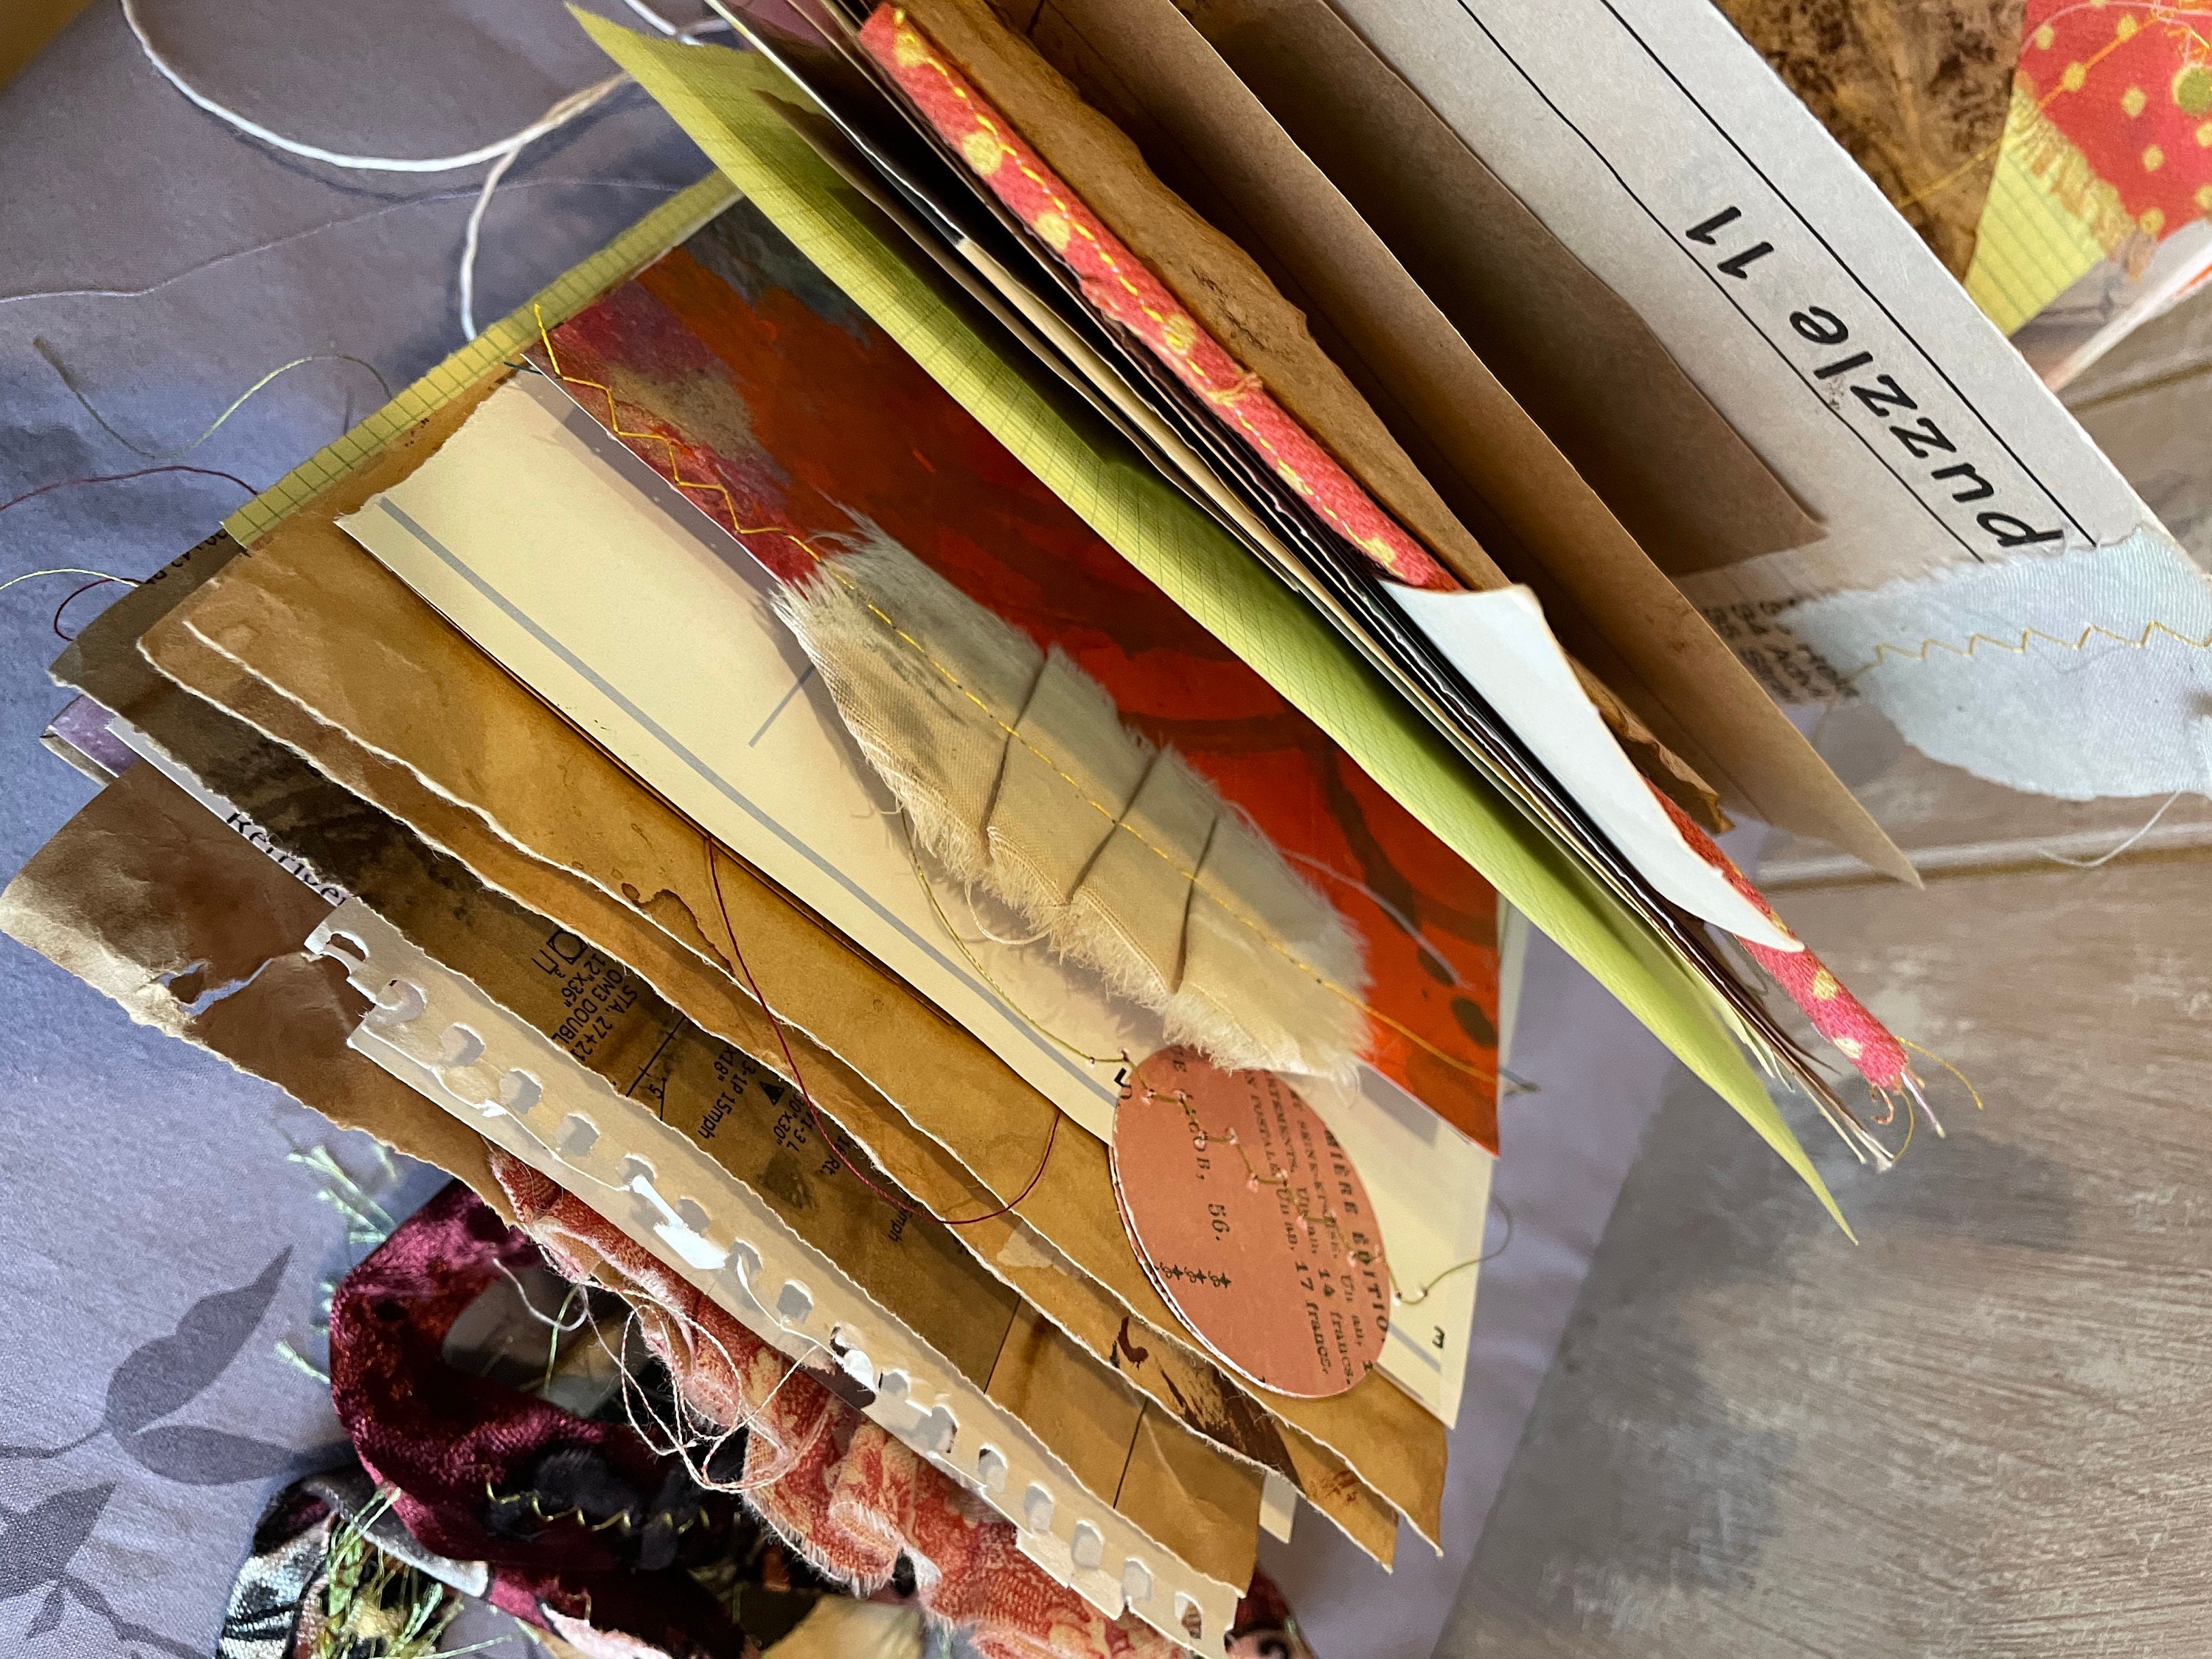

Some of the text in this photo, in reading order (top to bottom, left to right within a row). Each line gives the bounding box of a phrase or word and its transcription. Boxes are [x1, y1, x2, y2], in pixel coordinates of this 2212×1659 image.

[1686, 206, 2065, 547] puzzle 11
[552, 967, 622, 1048] OM3 DOUBL
[606, 984, 637, 1019] STA.
[692, 1089, 735, 1140] 15mph
[1207, 1202, 1230, 1241] 56.
[1295, 1260, 1312, 1292] 17
[1352, 1231, 1391, 1343] ÉDITIO
